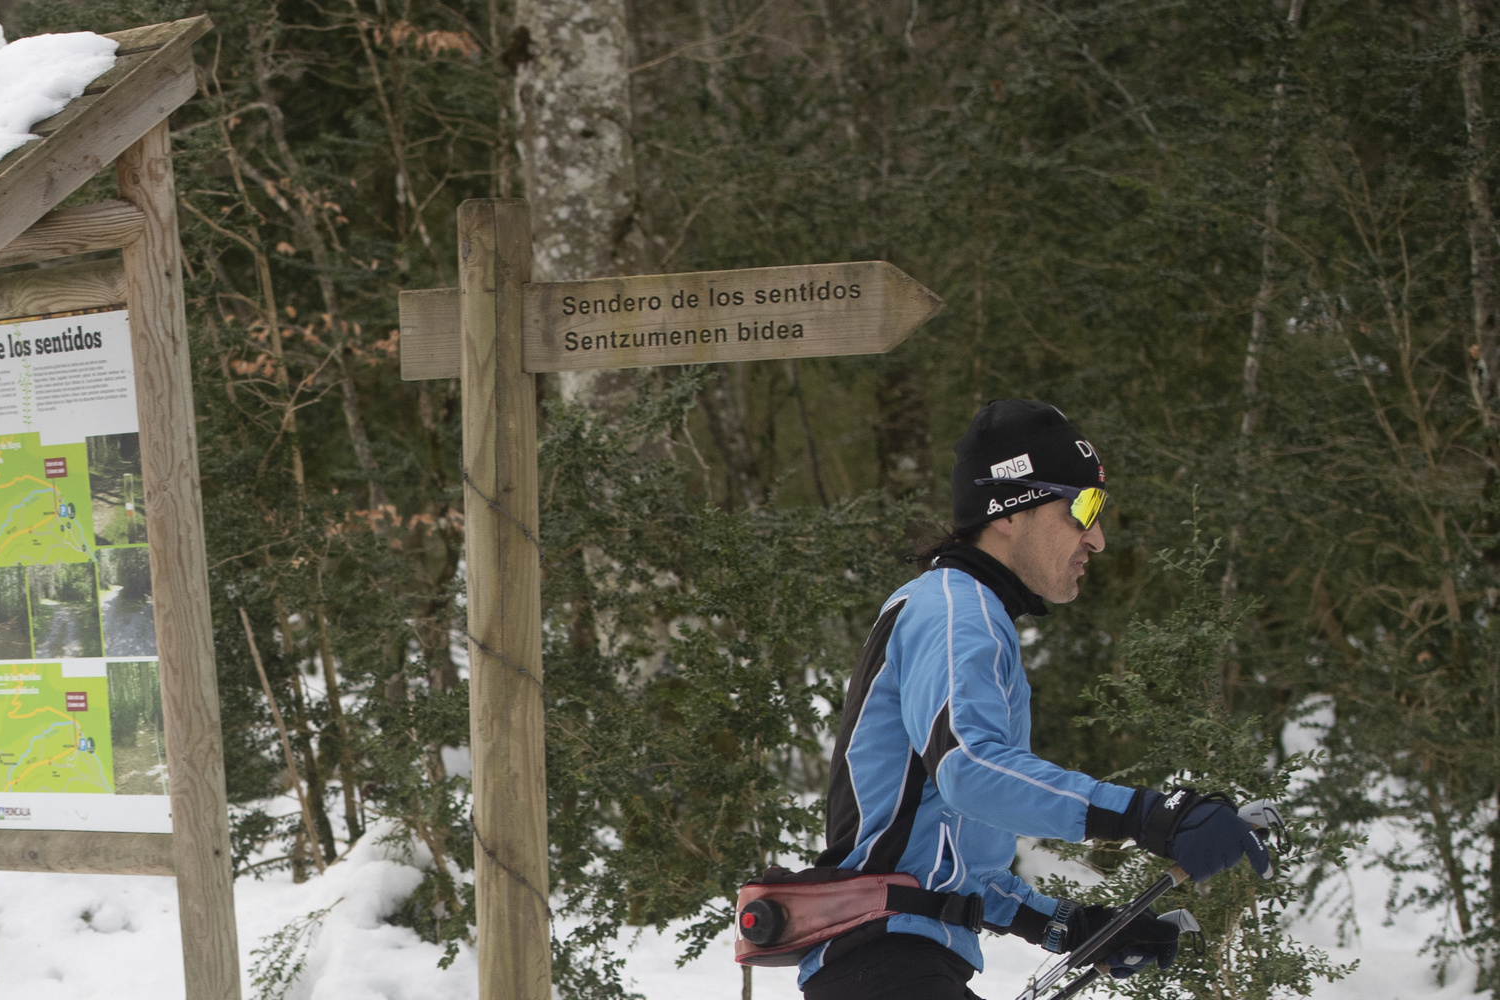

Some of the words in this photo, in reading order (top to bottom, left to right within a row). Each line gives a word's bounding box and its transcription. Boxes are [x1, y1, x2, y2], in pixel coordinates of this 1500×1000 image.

[562, 291, 662, 316] Sendero
[671, 289, 700, 309] de
[709, 288, 745, 307] los
[754, 280, 862, 305] sentidos
[8, 334, 32, 358] los
[35, 326, 102, 354] sentidos
[564, 324, 728, 352] Sentzumenen
[737, 320, 805, 343] bidea
[996, 459, 1028, 479] DNB
